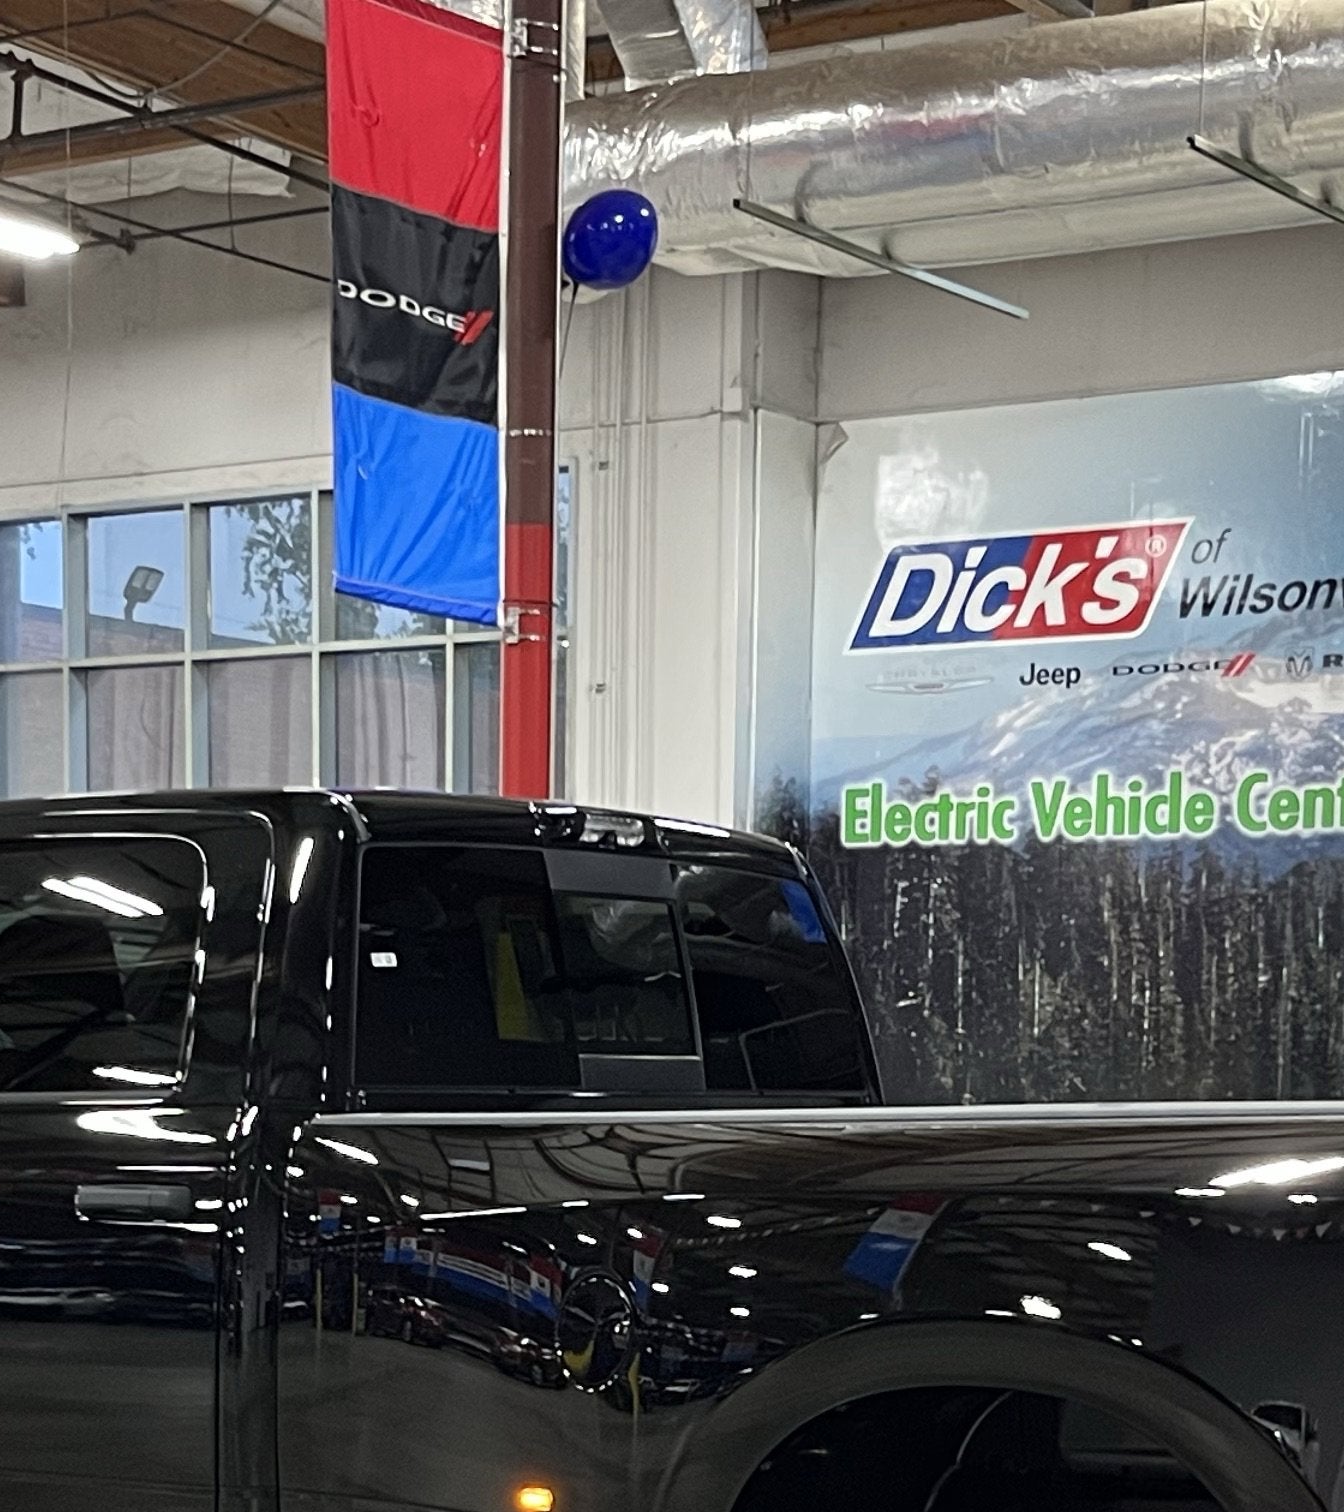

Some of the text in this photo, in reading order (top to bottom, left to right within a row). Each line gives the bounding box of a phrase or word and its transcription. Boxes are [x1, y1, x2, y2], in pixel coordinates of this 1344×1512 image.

[337, 278, 468, 334] DODGE
[1191, 527, 1232, 564] of
[868, 536, 1149, 638] Dick's
[1018, 662, 1082, 689] Jeep
[844, 782, 1015, 844] Electric
[1030, 771, 1215, 838] Vehicle
